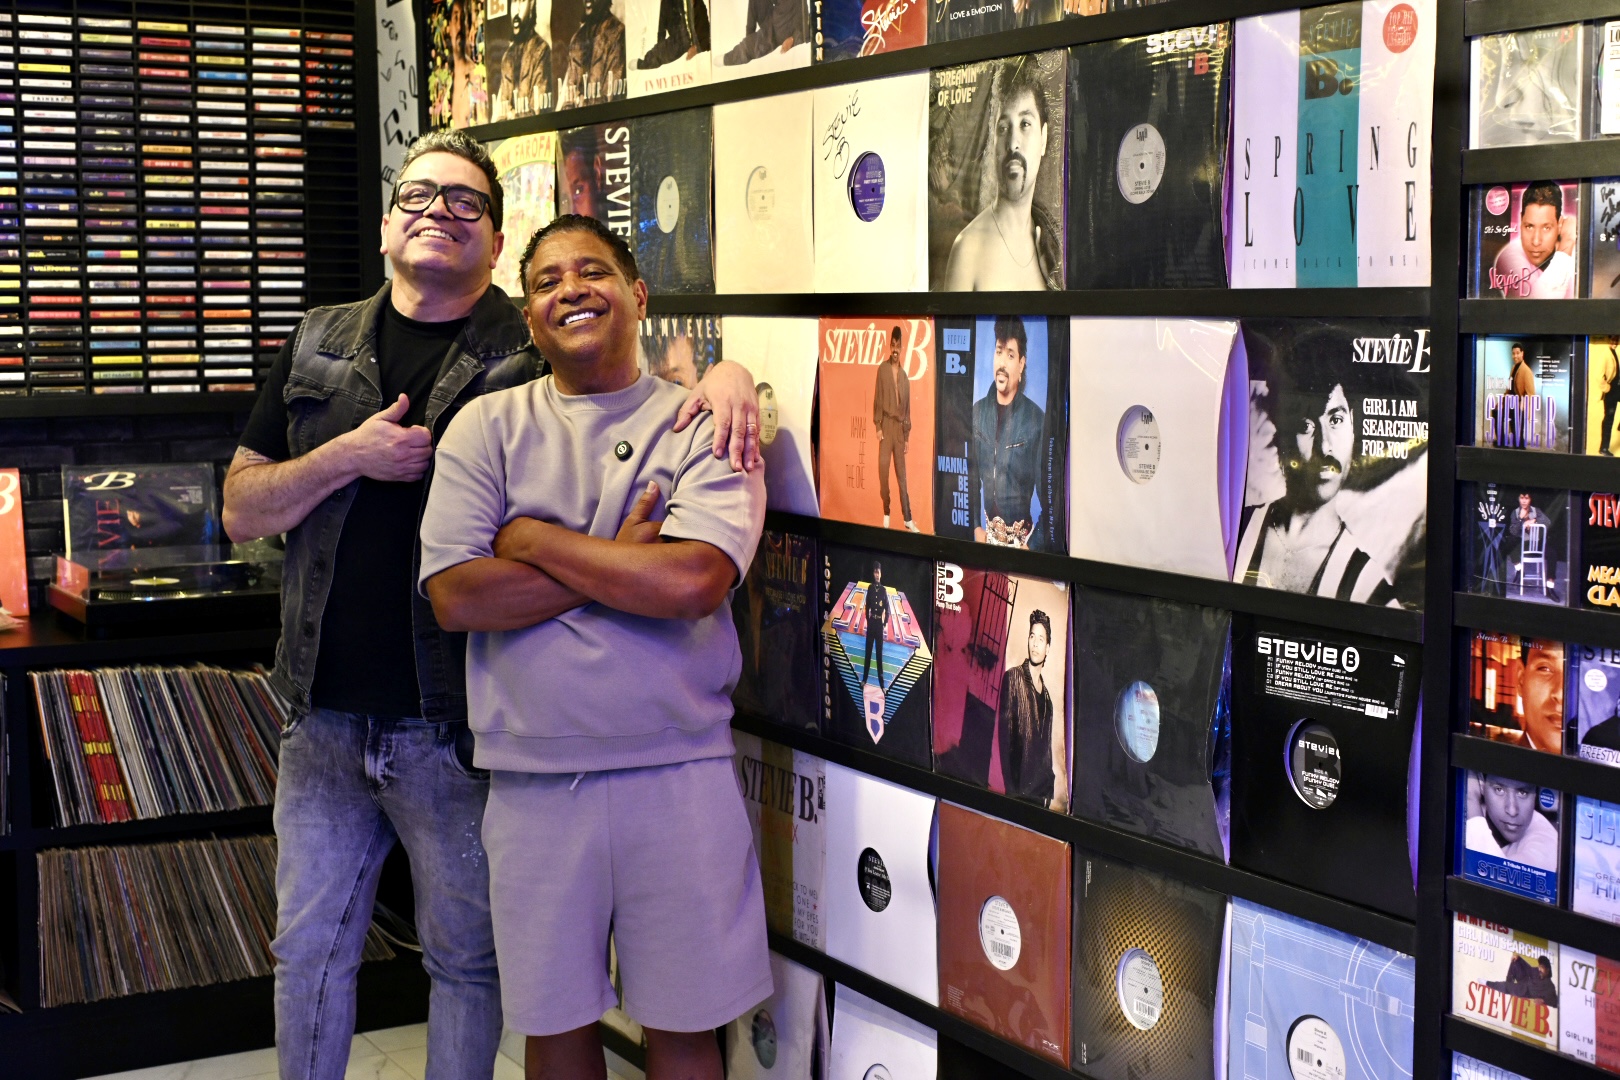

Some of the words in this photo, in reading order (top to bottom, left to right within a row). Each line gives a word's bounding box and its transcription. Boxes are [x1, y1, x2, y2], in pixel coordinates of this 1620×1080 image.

[950, 9, 965, 20] LOVE
[965, 8, 971, 17] &
[971, 4, 1002, 16] EMOTION
[1194, 52, 1209, 75] B
[645, 81, 655, 93] IN
[656, 78, 669, 91] MY
[671, 73, 694, 88] EYES
[1305, 58, 1353, 101] B.
[937, 89, 950, 107] OF
[1244, 121, 1418, 181] SPRING
[604, 126, 632, 237] STEVIE
[1244, 181, 1417, 248] LOVE
[640, 318, 653, 336] IN
[661, 318, 678, 337] MY
[687, 319, 721, 338] EYES
[822, 322, 887, 366] STEVIE
[903, 319, 932, 380] B
[1352, 333, 1413, 365] STEVIE
[945, 353, 967, 375] B.
[1362, 397, 1391, 416] GIRL
[1391, 399, 1397, 417] I
[1398, 400, 1418, 418] AM
[1362, 419, 1429, 441] SEARCHING
[1484, 393, 1541, 449] STEVIE
[1546, 396, 1557, 449] B
[1362, 439, 1385, 458] FOR
[1386, 440, 1409, 460] YOU
[937, 455, 968, 475] WANNA
[84, 471, 137, 491] B
[957, 474, 969, 493] BE
[952, 491, 970, 510] THE
[951, 509, 970, 528] ONE
[823, 555, 831, 604] LOVE
[937, 560, 946, 604] STEVIE
[945, 562, 964, 604] B
[823, 632, 832, 719] EMOTION
[863, 684, 887, 745] B
[741, 755, 797, 816] STEVIE
[799, 775, 818, 824] B.
[1507, 862, 1521, 870] Tribute
[1477, 860, 1532, 890] STEVIE
[1535, 875, 1552, 896] B.
[797, 895, 810, 908] ONE
[1459, 926, 1478, 942] GIRL
[1484, 933, 1500, 949] AM
[1458, 941, 1476, 957] FOR
[1478, 944, 1495, 963] YOU
[1466, 981, 1531, 1029] STEVIE
[1534, 1003, 1553, 1038] B.
[1042, 1039, 1059, 1050] ZYX
[1566, 1031, 1581, 1041] GIRL
[1582, 1036, 1594, 1045] I'M
[1577, 1049, 1588, 1059] THE
